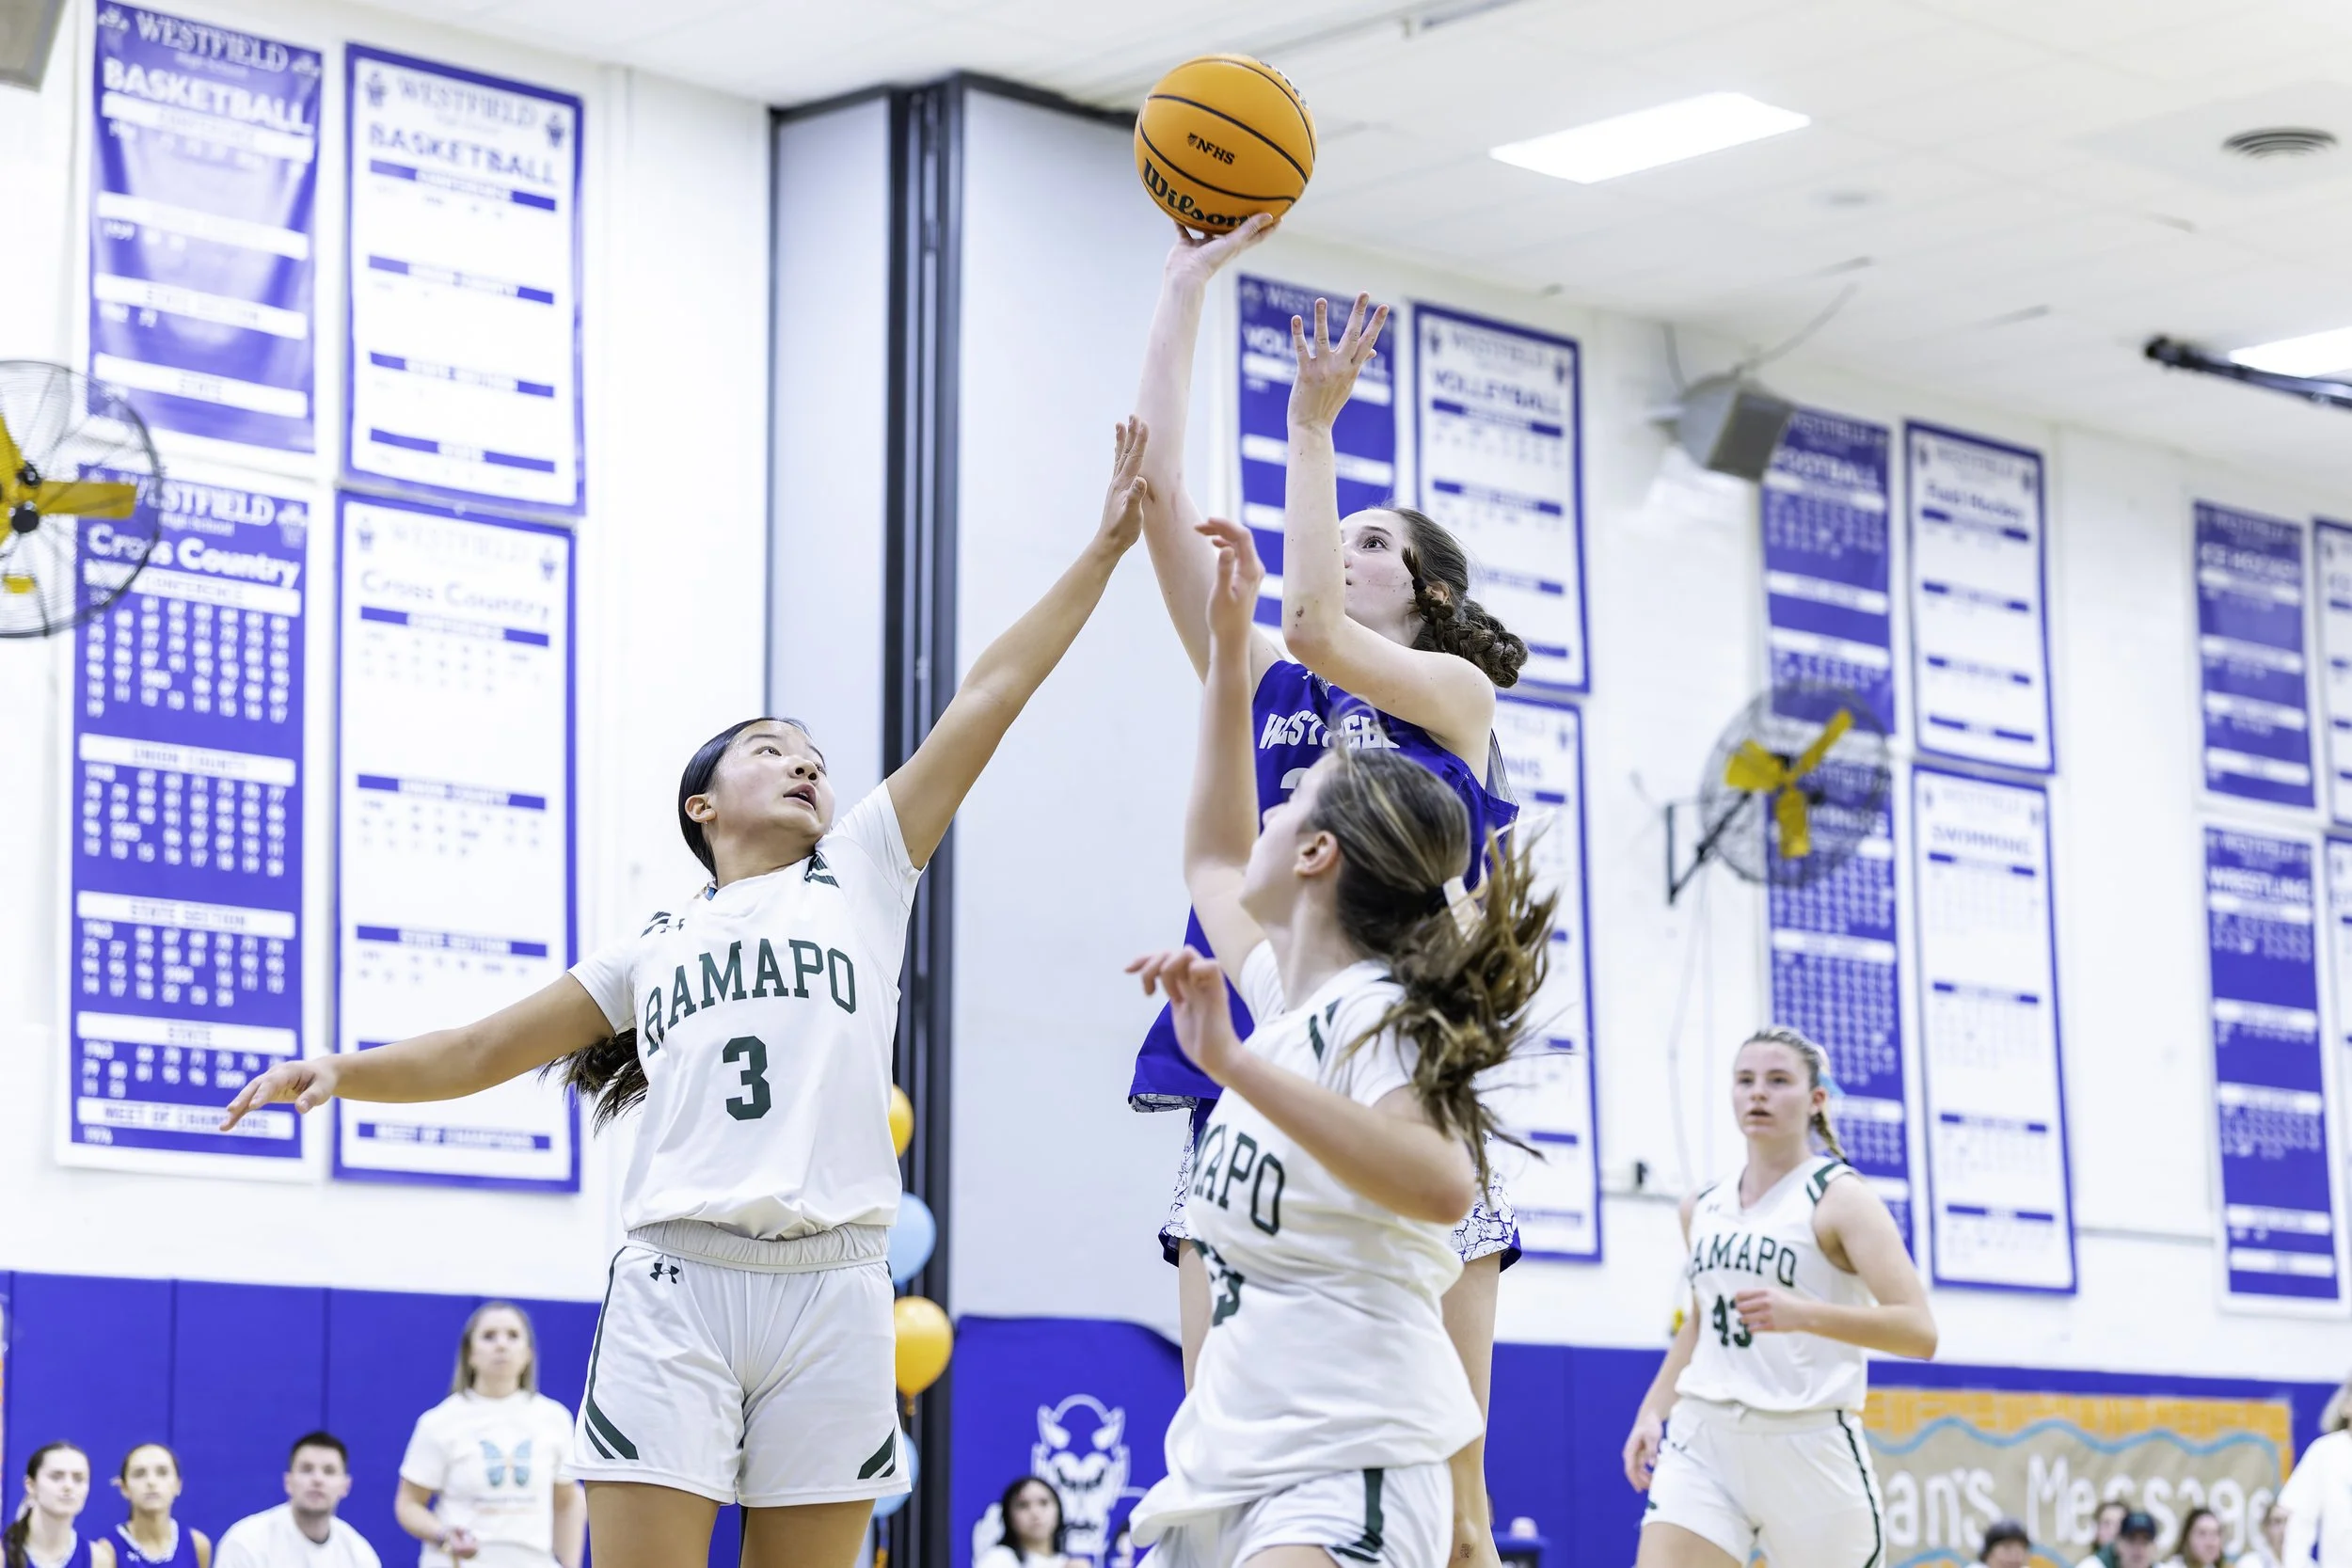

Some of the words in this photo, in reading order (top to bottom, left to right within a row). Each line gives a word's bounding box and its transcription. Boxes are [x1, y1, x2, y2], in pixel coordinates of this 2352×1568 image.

[135, 9, 289, 73] WESTFIELD
[103, 54, 314, 136] BASKETBALL
[368, 121, 558, 187] BASKETBALL
[1195, 136, 1236, 166] NFHS
[1143, 157, 1250, 229] Wilson
[177, 537, 301, 588] Country
[644, 938, 856, 1058] RAMAPO
[723, 1036, 771, 1120] 3
[1690, 1232, 1797, 1289] AMAPO
